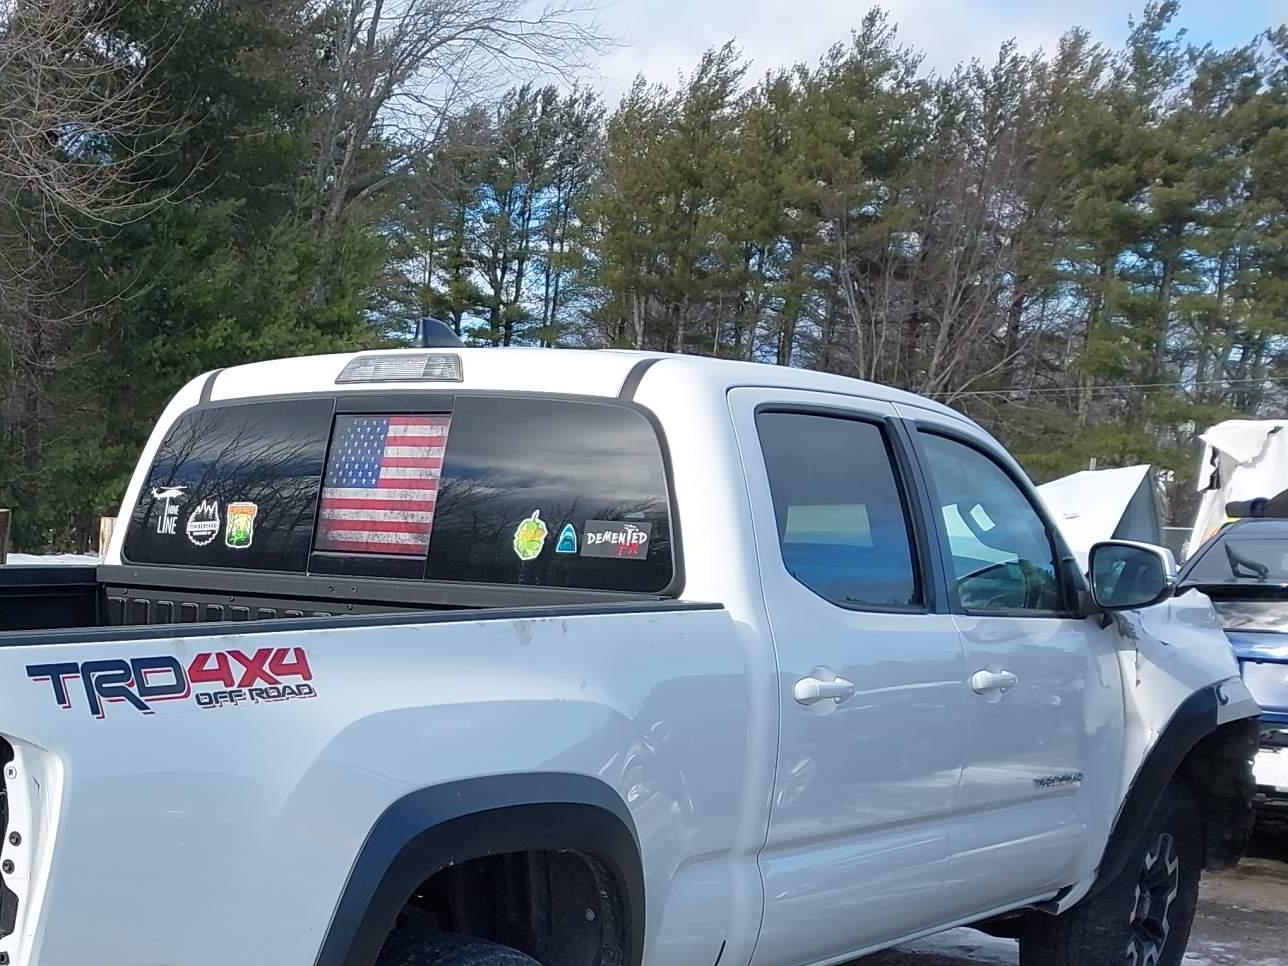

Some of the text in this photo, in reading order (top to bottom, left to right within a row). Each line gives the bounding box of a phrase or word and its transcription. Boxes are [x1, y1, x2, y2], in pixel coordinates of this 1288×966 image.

[157, 515, 178, 534] LINE
[587, 524, 647, 546] DEMENTED
[26, 655, 191, 719] TRD
[195, 683, 317, 709] OFF ROAD
